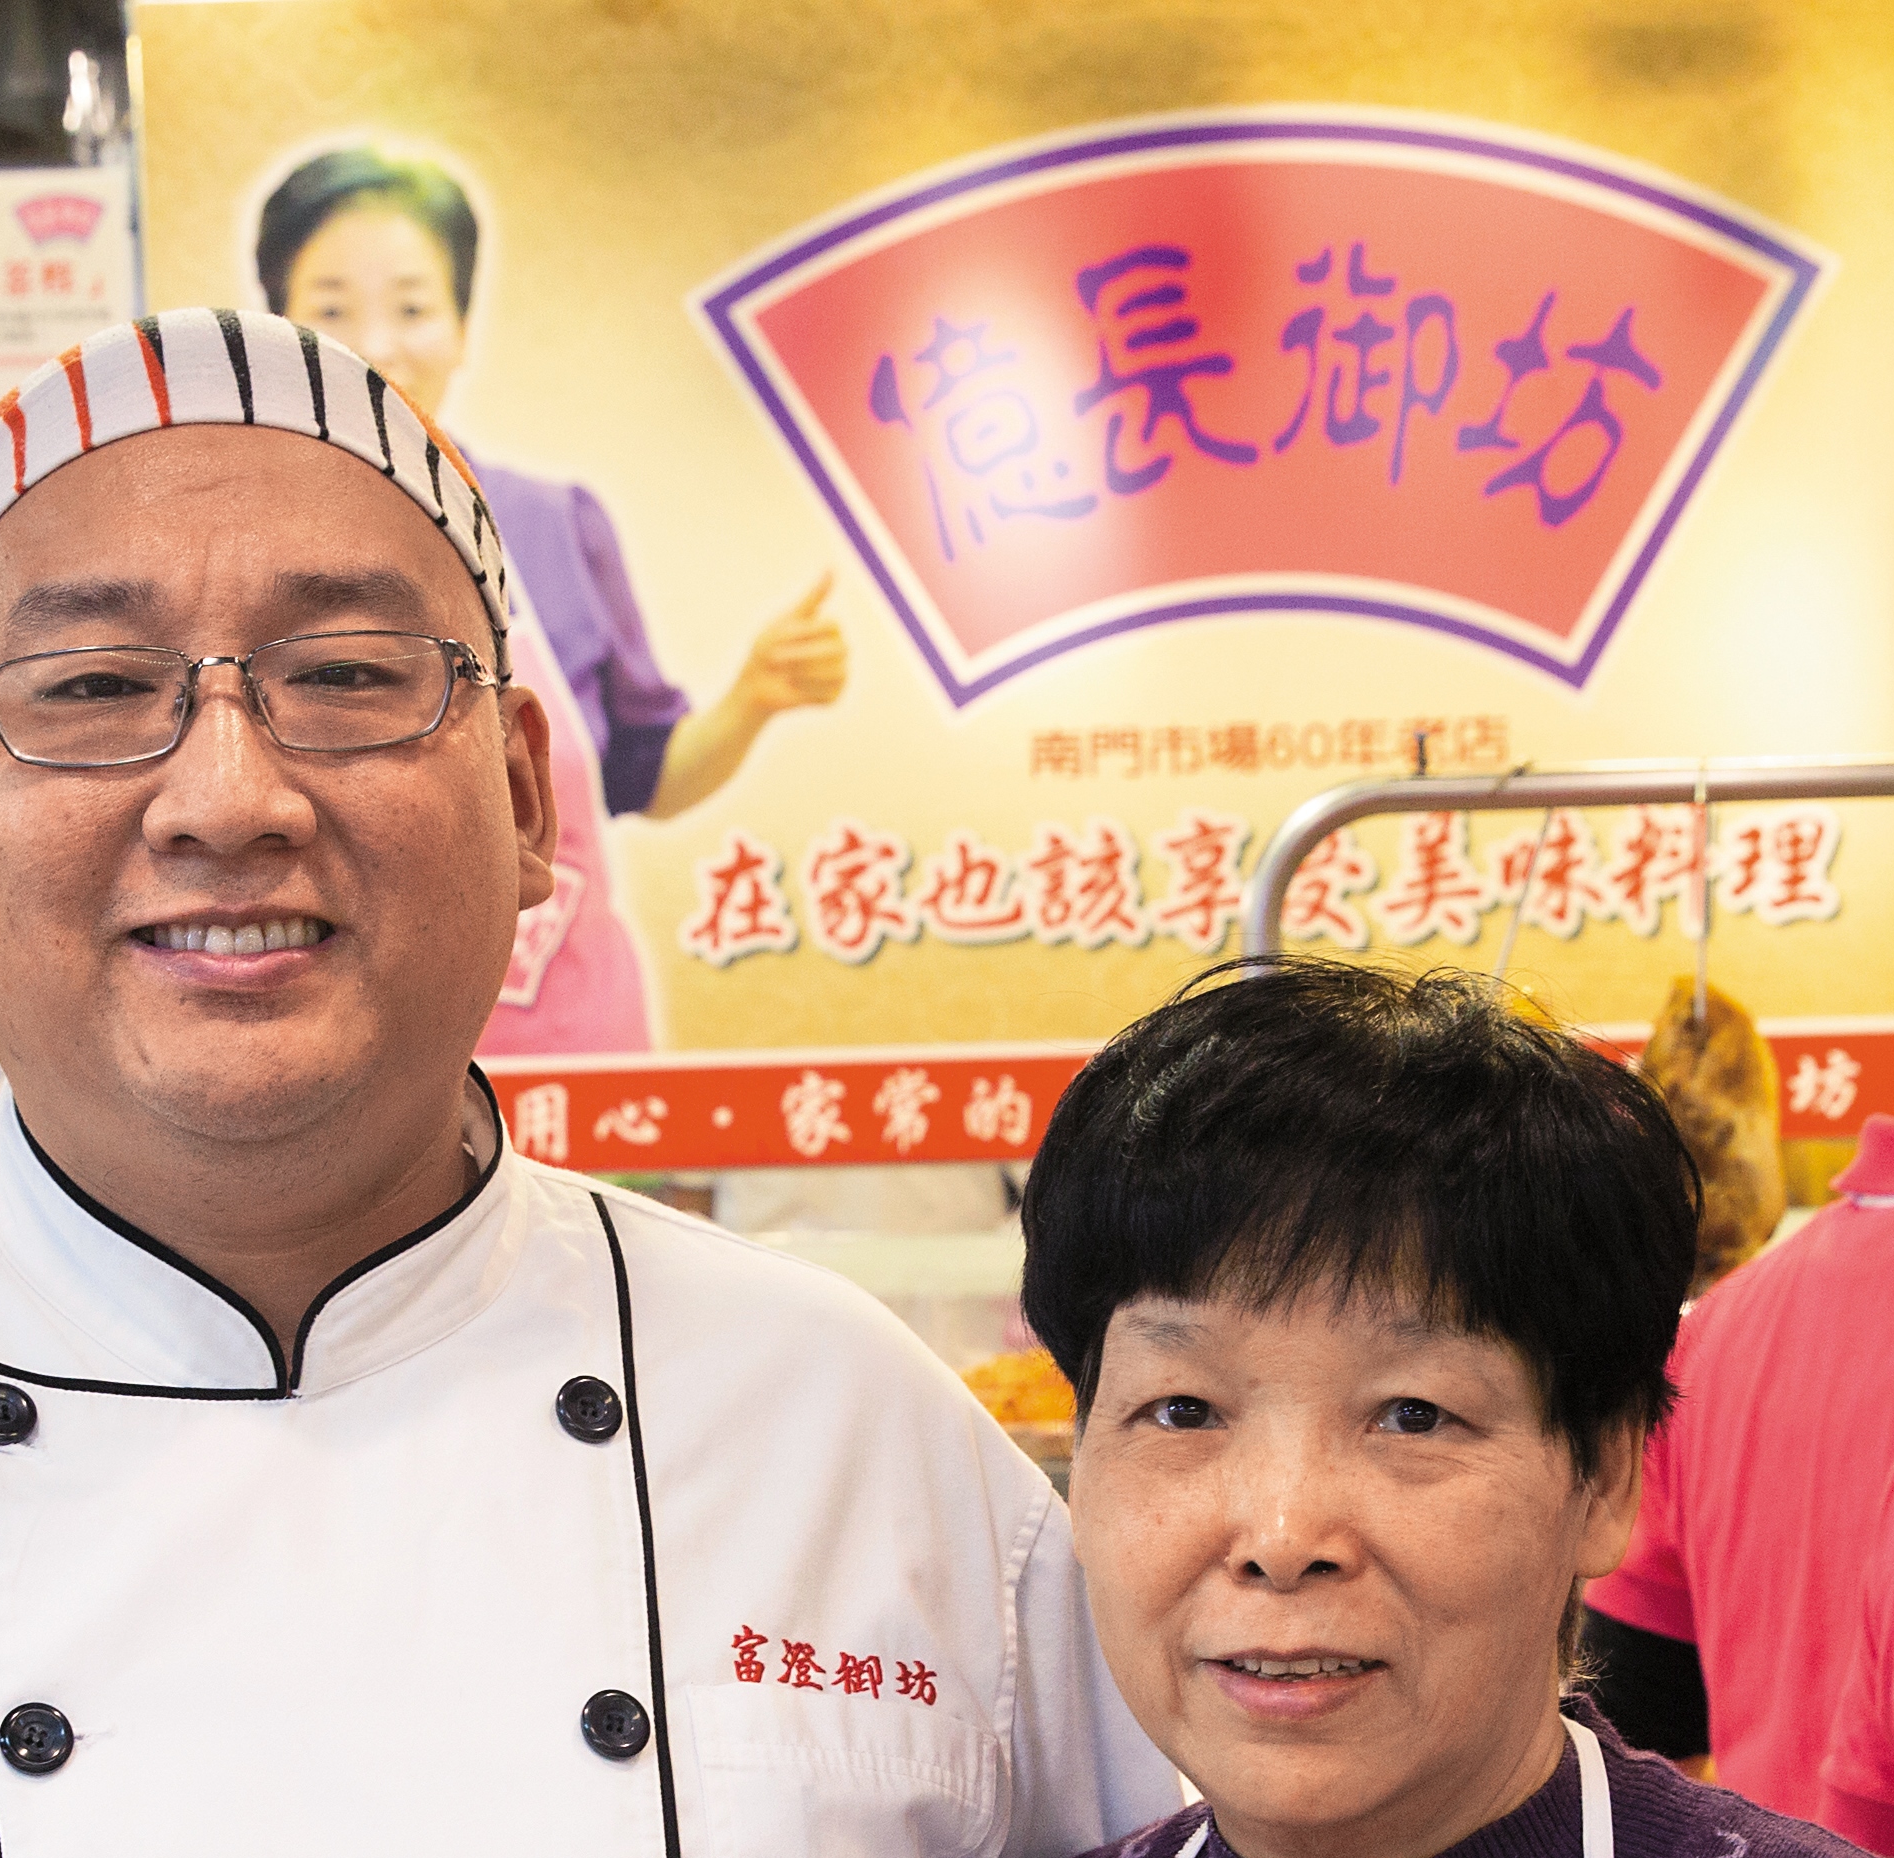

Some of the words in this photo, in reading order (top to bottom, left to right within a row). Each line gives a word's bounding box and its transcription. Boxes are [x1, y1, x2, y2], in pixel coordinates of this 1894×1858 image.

[869, 242, 1663, 562] 億長御坊
[1030, 714, 1509, 780] 南門市場60年老店
[687, 800, 1827, 955] 在家也該享受美味料理
[731, 1624, 938, 1706] 富澄御坊
